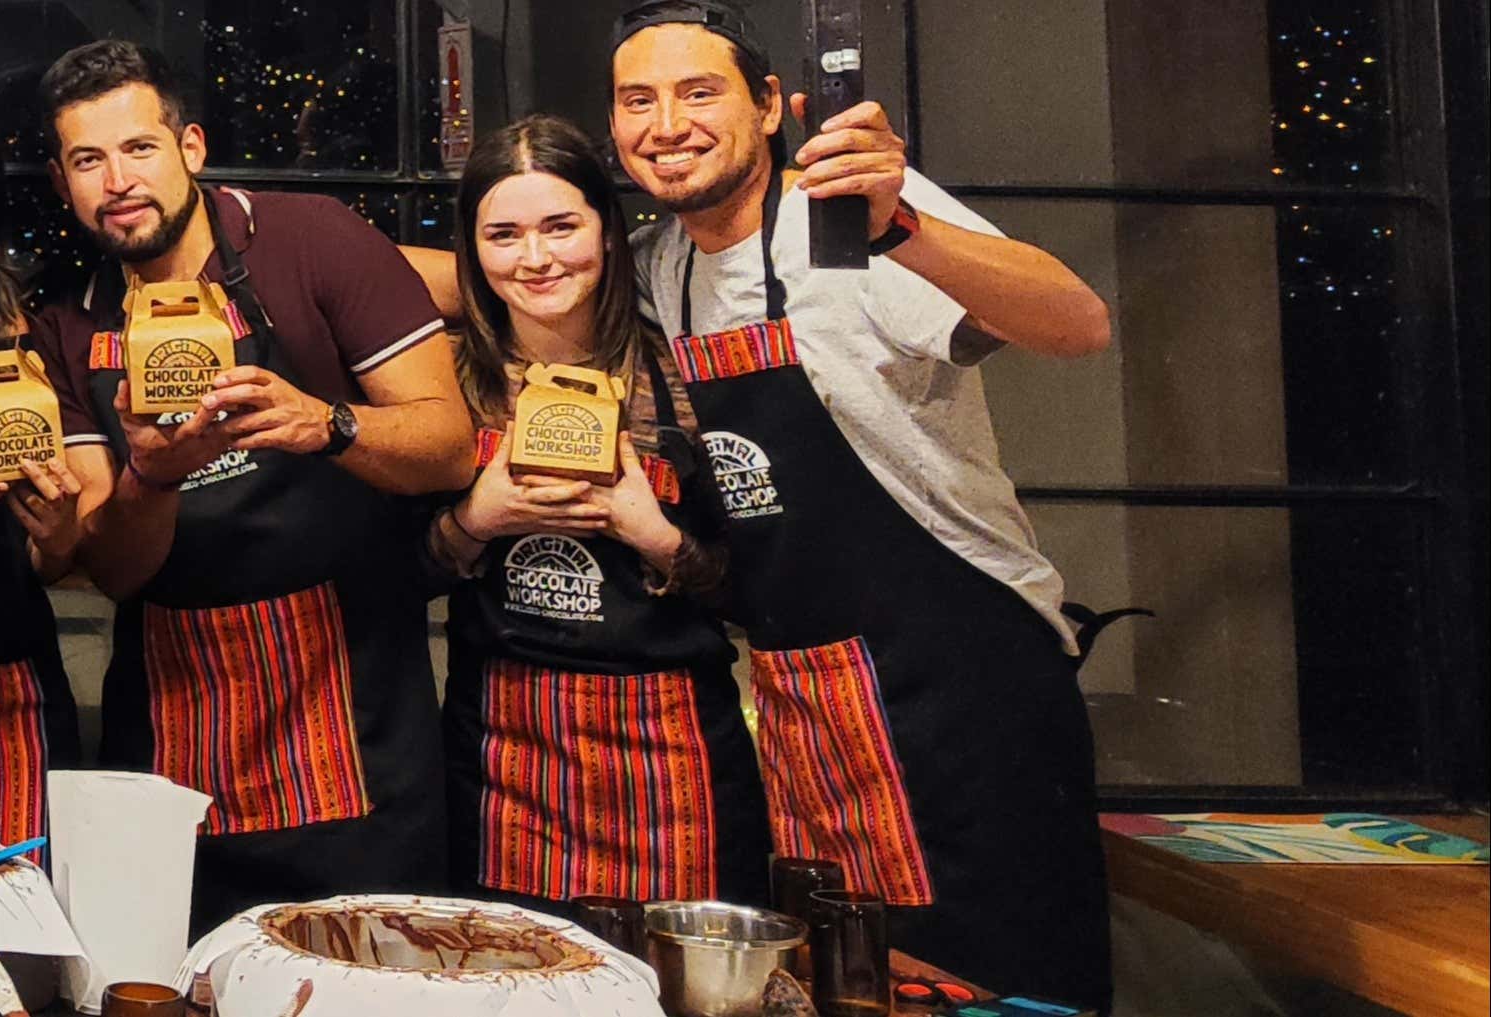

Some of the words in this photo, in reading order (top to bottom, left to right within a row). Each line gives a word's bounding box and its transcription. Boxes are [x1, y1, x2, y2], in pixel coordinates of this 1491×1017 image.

[144, 384, 217, 398] WORKSHO
[526, 426, 604, 444] CHOCOLATE
[524, 439, 602, 457] WORKSHOP
[724, 486, 779, 510] KSHOP
[511, 536, 594, 576] ORIGINAL
[506, 568, 601, 596] CHOCOLATE
[507, 586, 602, 613] WORKSHOP
